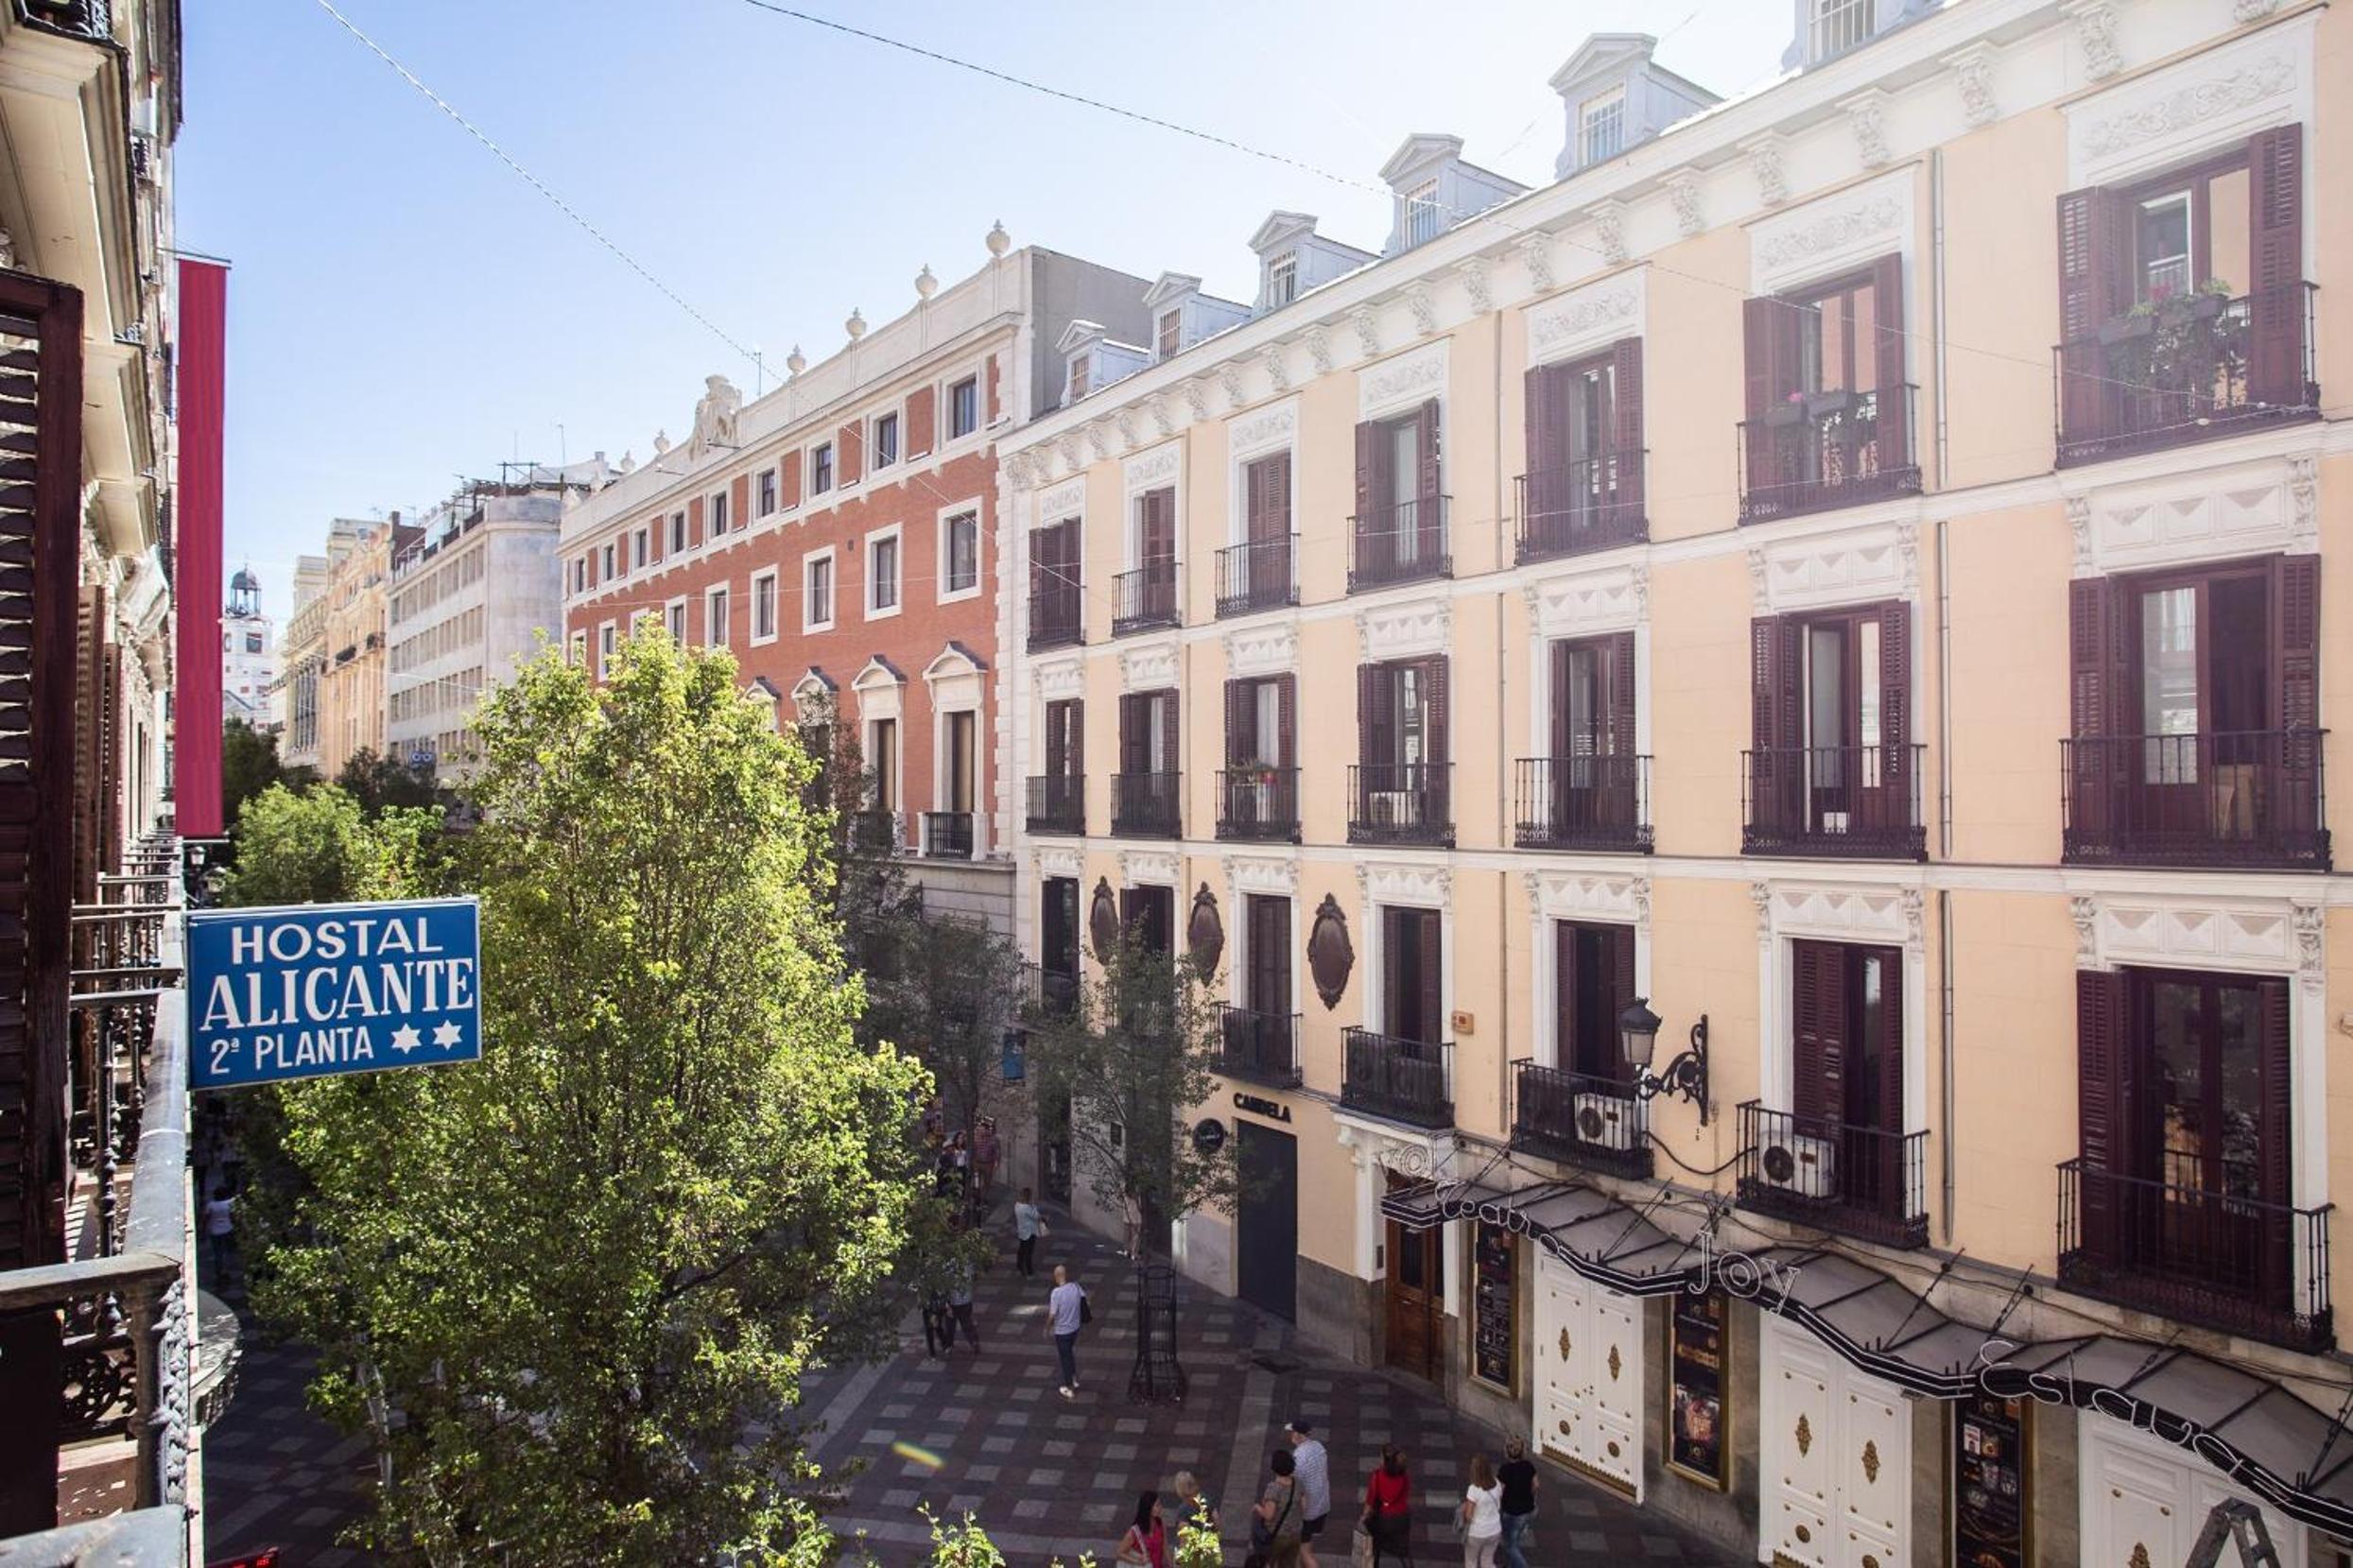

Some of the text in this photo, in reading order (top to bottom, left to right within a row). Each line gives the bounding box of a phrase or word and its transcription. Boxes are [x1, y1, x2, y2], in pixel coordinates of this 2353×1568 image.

[231, 917, 444, 965] HOSTAL
[199, 957, 474, 1031] ALICANTE
[255, 1025, 375, 1071] PLANTA
[1980, 1340, 2247, 1489] Eslava
